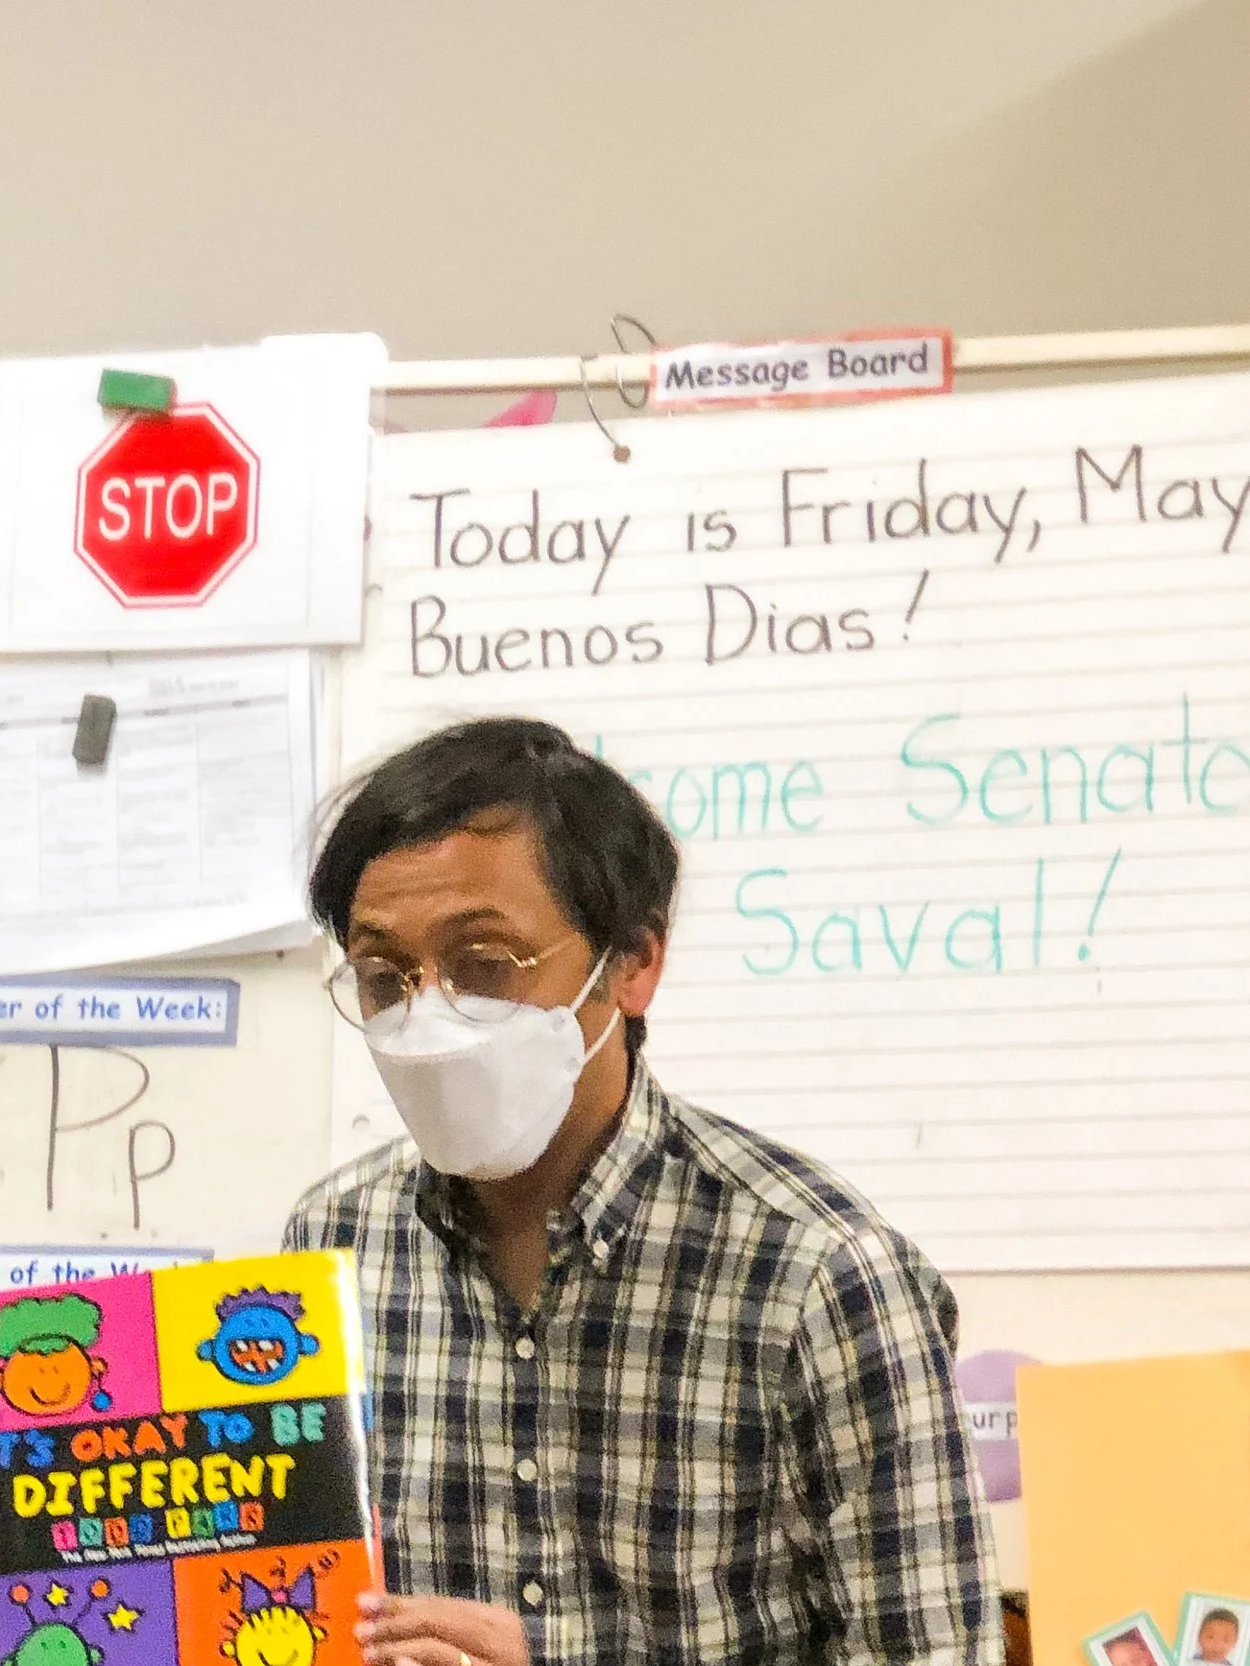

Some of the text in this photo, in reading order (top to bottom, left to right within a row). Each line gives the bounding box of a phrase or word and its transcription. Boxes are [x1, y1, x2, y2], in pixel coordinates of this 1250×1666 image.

[665, 342, 929, 392] Message Board
[98, 471, 239, 542] STOP
[410, 444, 1250, 597] Today is Friday, May
[410, 594, 665, 678] Buenos
[735, 845, 1122, 976] Saval!
[35, 994, 64, 1020] of
[77, 995, 121, 1020] the
[135, 995, 222, 1020] Week:
[10, 1258, 39, 1285] of
[54, 1260, 96, 1285] the
[70, 1412, 189, 1463] OKAY
[198, 1409, 255, 1448] TO
[270, 1401, 328, 1448] BE
[971, 1411, 1018, 1435] urp
[12, 1452, 296, 1519] DIFFERENT
